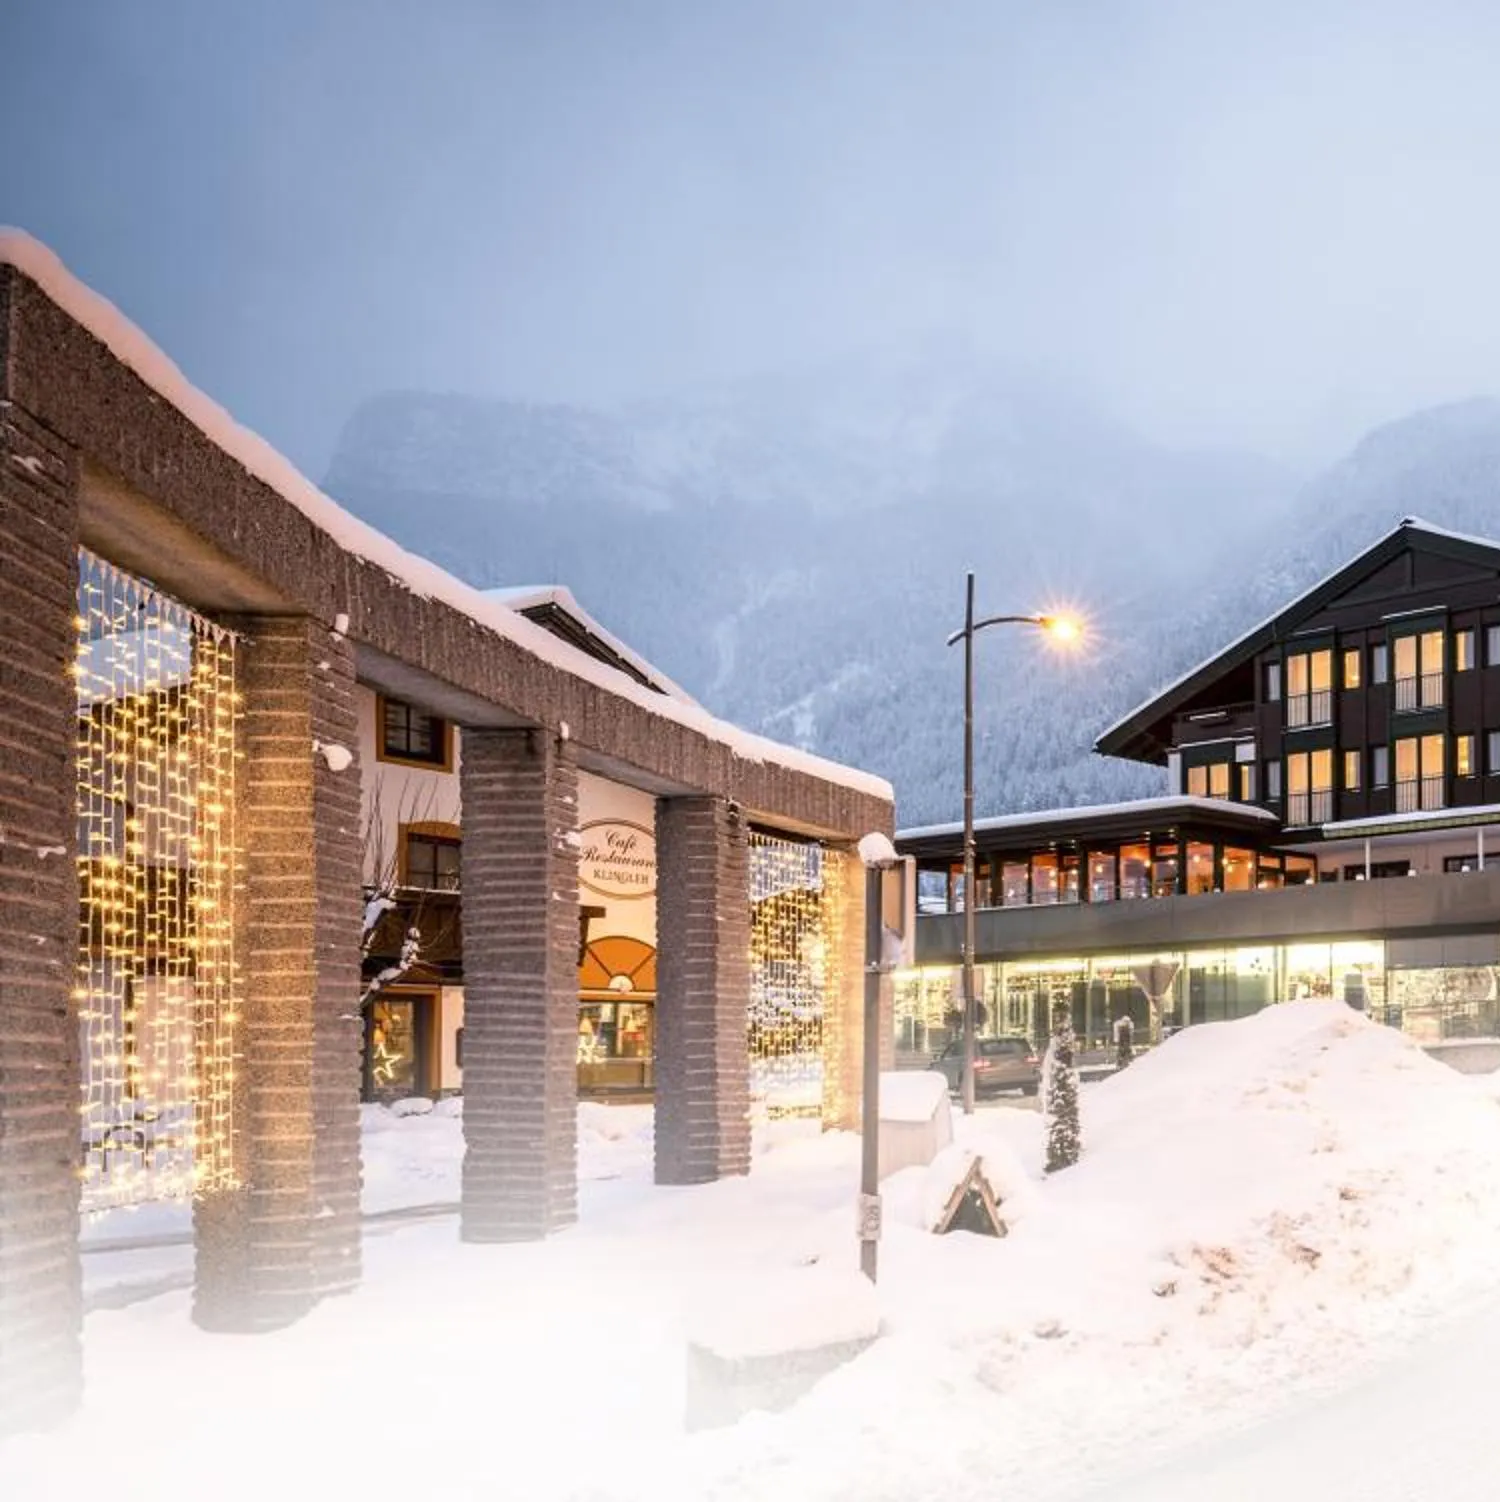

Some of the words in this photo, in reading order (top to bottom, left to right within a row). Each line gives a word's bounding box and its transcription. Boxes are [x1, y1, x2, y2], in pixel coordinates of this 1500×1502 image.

[605, 829, 638, 855] Café
[583, 844, 656, 869] Restauran
[593, 868, 649, 885] KLINGLER
